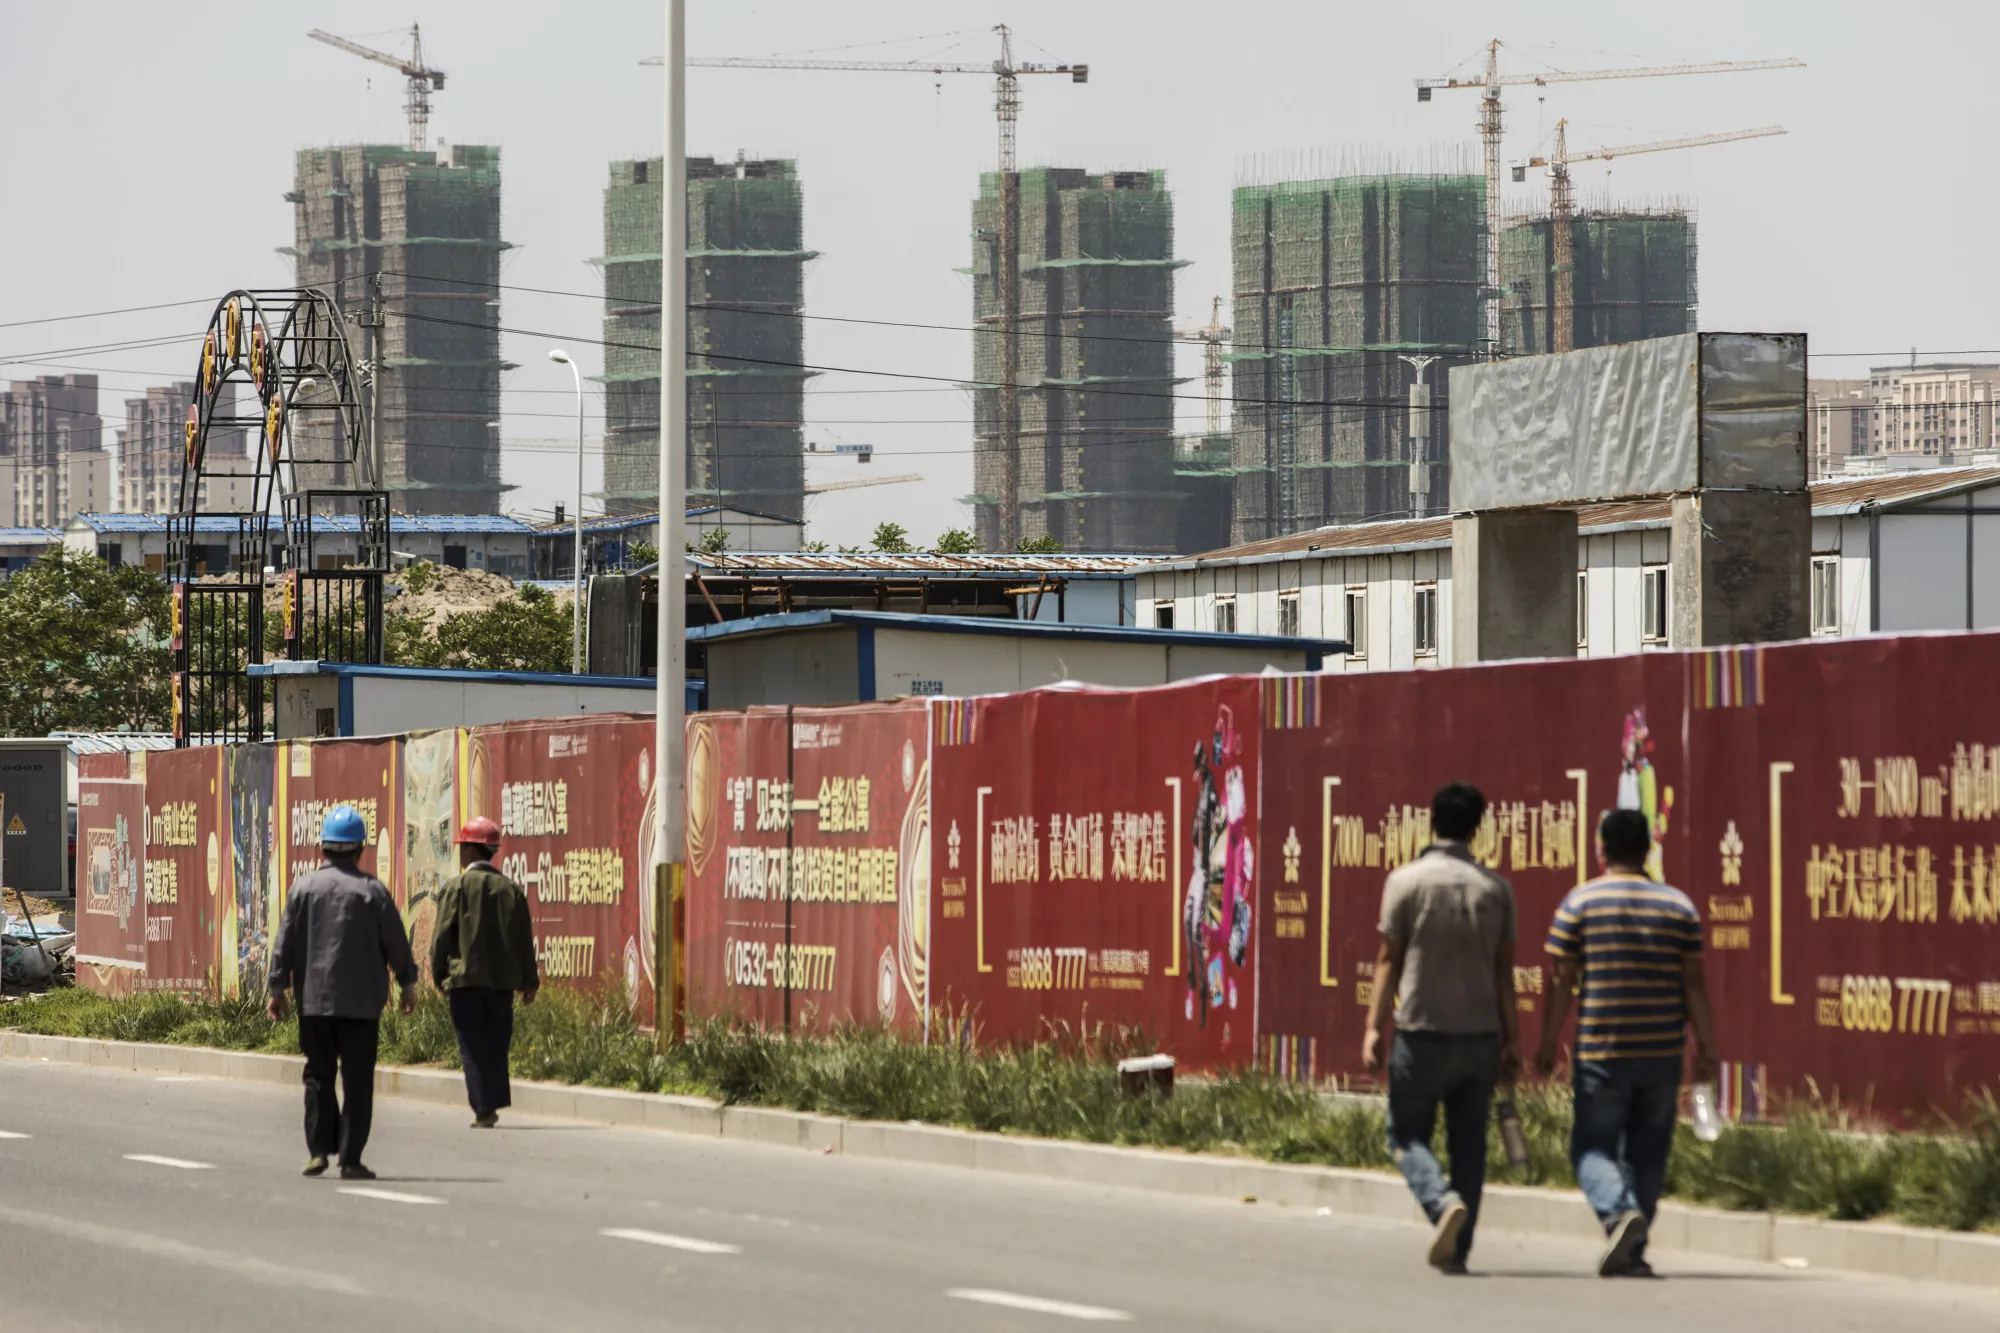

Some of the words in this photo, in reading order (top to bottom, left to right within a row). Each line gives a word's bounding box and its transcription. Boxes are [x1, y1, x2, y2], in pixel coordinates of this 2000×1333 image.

[501, 778, 568, 837] 典藏精品公寓
[990, 815, 1039, 884] 雨润金街
[1048, 812, 1104, 883] 黄金旺铺
[1110, 810, 1167, 882] 荣耀发售
[734, 939, 836, 992] 0532-68687777
[1021, 946, 1053, 990] 6868
[1054, 946, 1087, 990] 7777
[1841, 974, 1893, 1033] 6868
[1895, 976, 1952, 1036] 7777
